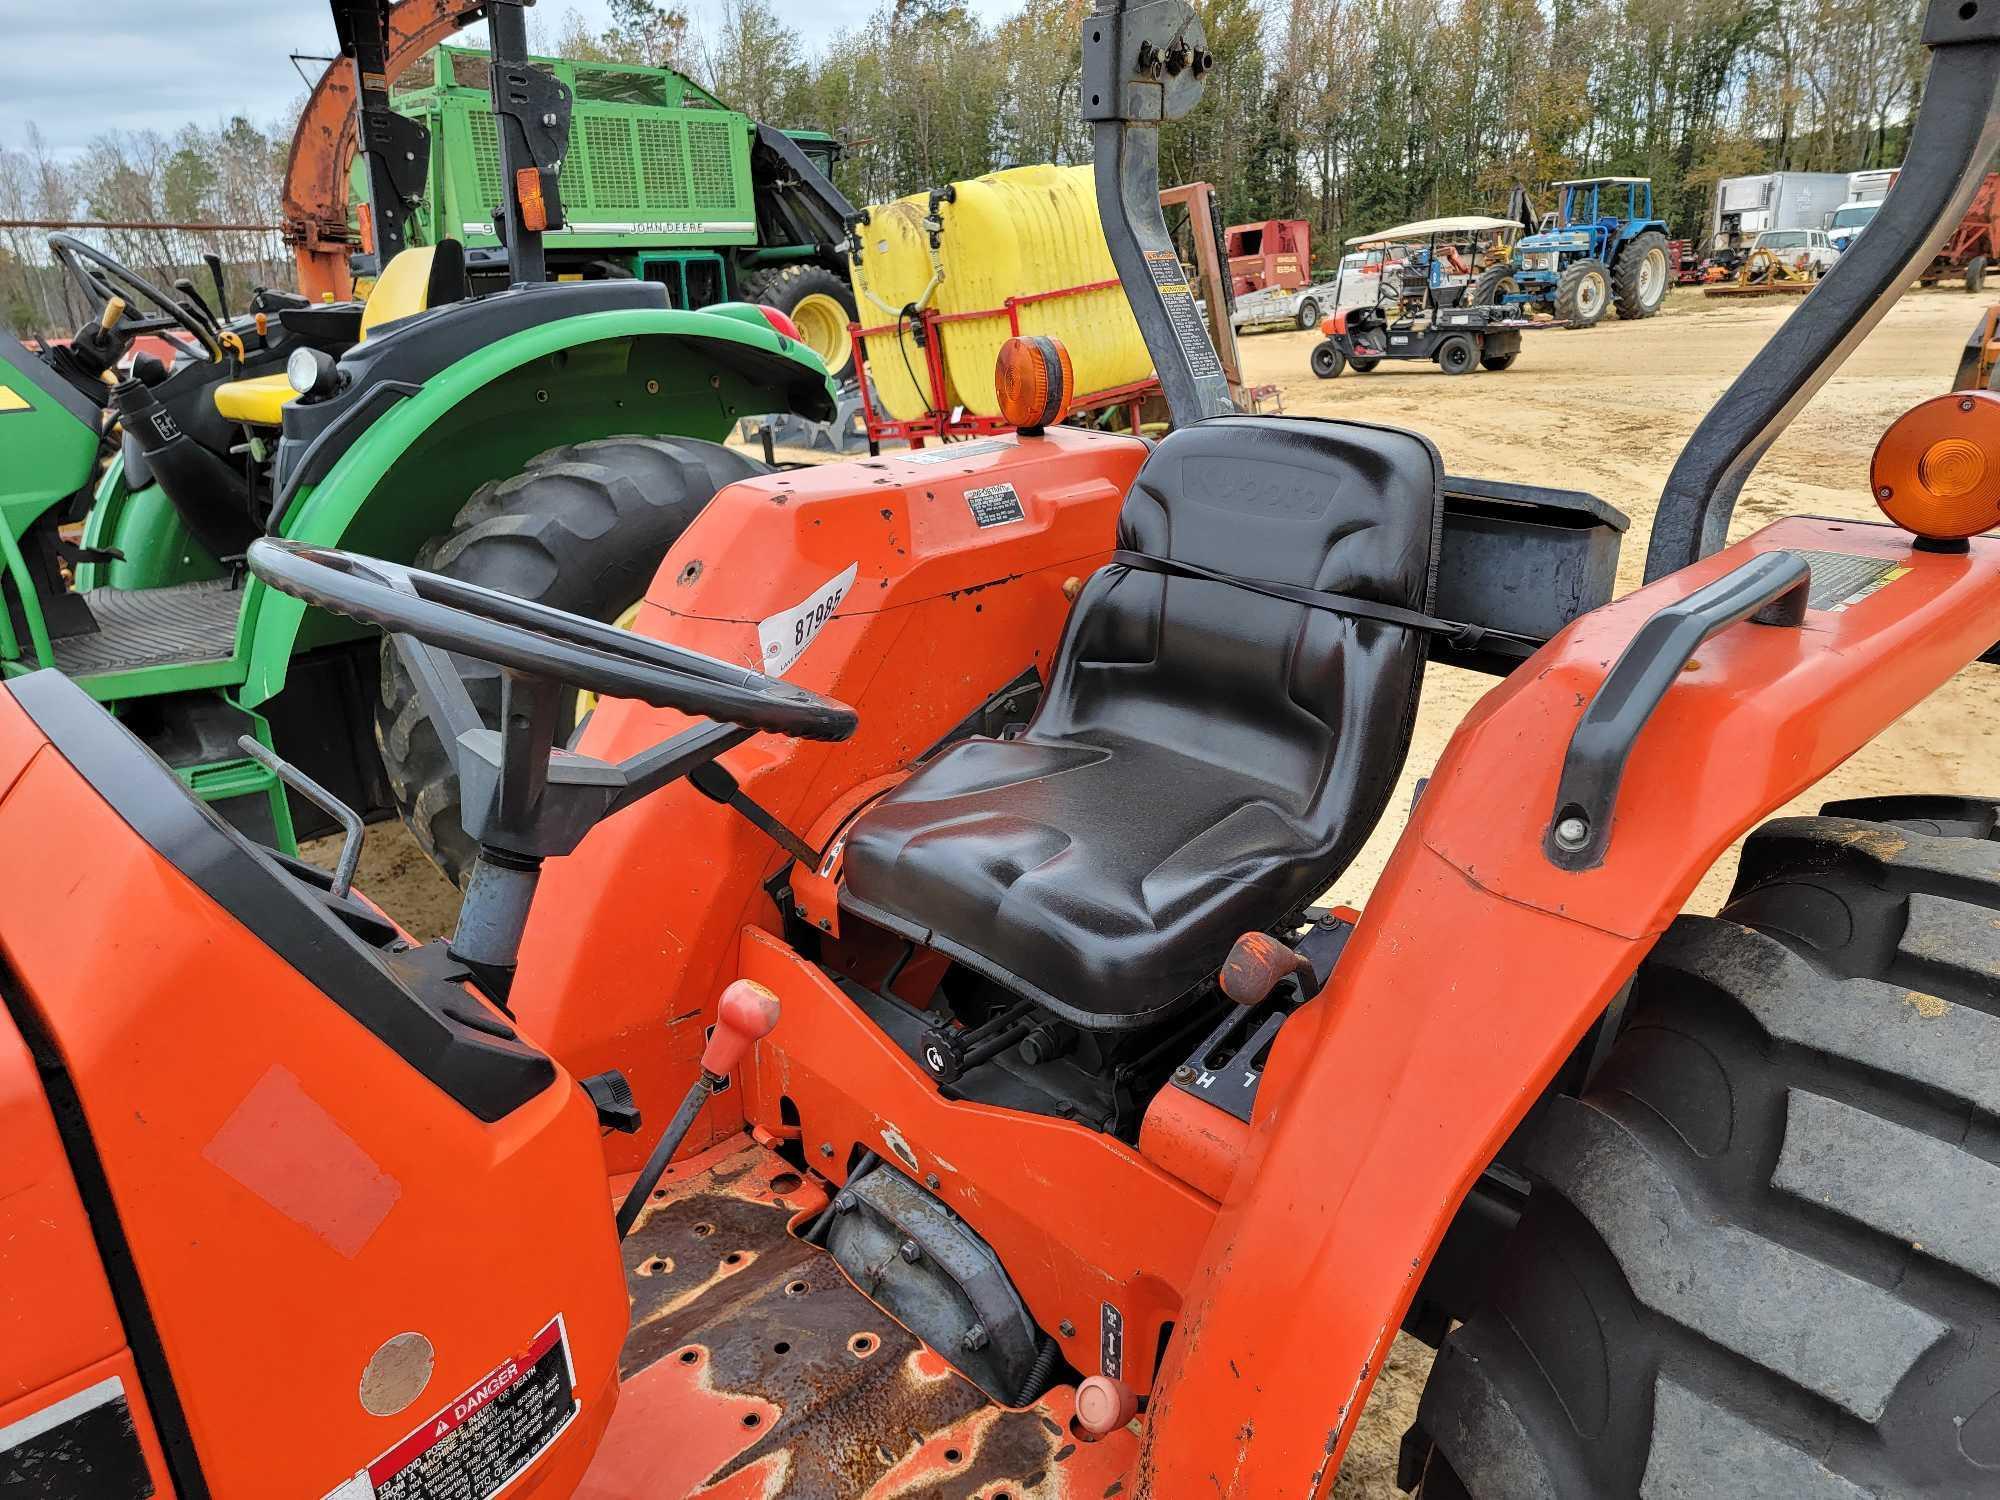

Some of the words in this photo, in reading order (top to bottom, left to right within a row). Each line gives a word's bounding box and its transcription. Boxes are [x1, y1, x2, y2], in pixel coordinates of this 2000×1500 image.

[630, 223, 663, 233] JOHN
[666, 223, 704, 233] DEERE
[795, 588, 843, 646] 87985
[1195, 1071, 1216, 1088] H
[454, 1363, 518, 1420] DANGER
[377, 1481, 391, 1495] TO
[396, 1457, 422, 1482] AVOID
[426, 1424, 464, 1459] POSSIBLE
[468, 1400, 495, 1427] INJURY
[513, 1365, 537, 1393] DEATH
[430, 1469, 463, 1497] Machine
[467, 1453, 481, 1469] may
[485, 1437, 500, 1454] start
[545, 1383, 560, 1401] move
[380, 1480, 406, 1500] FROM
[410, 1473, 416, 1482] A
[420, 1440, 458, 1474] MACHINE
[410, 1477, 422, 1491] not
[426, 1461, 443, 1479] start
[447, 1441, 471, 1462] engine
[425, 1460, 460, 1490] terminals
[473, 1421, 510, 1452] bypassing
[441, 1474, 469, 1499] starting
[472, 1449, 499, 1475] circuitry
[480, 1480, 499, 1497] while
[502, 1453, 529, 1480] standing
[455, 1481, 470, 1498] only
[474, 1467, 490, 1482] from
[475, 1475, 491, 1493] PTO
